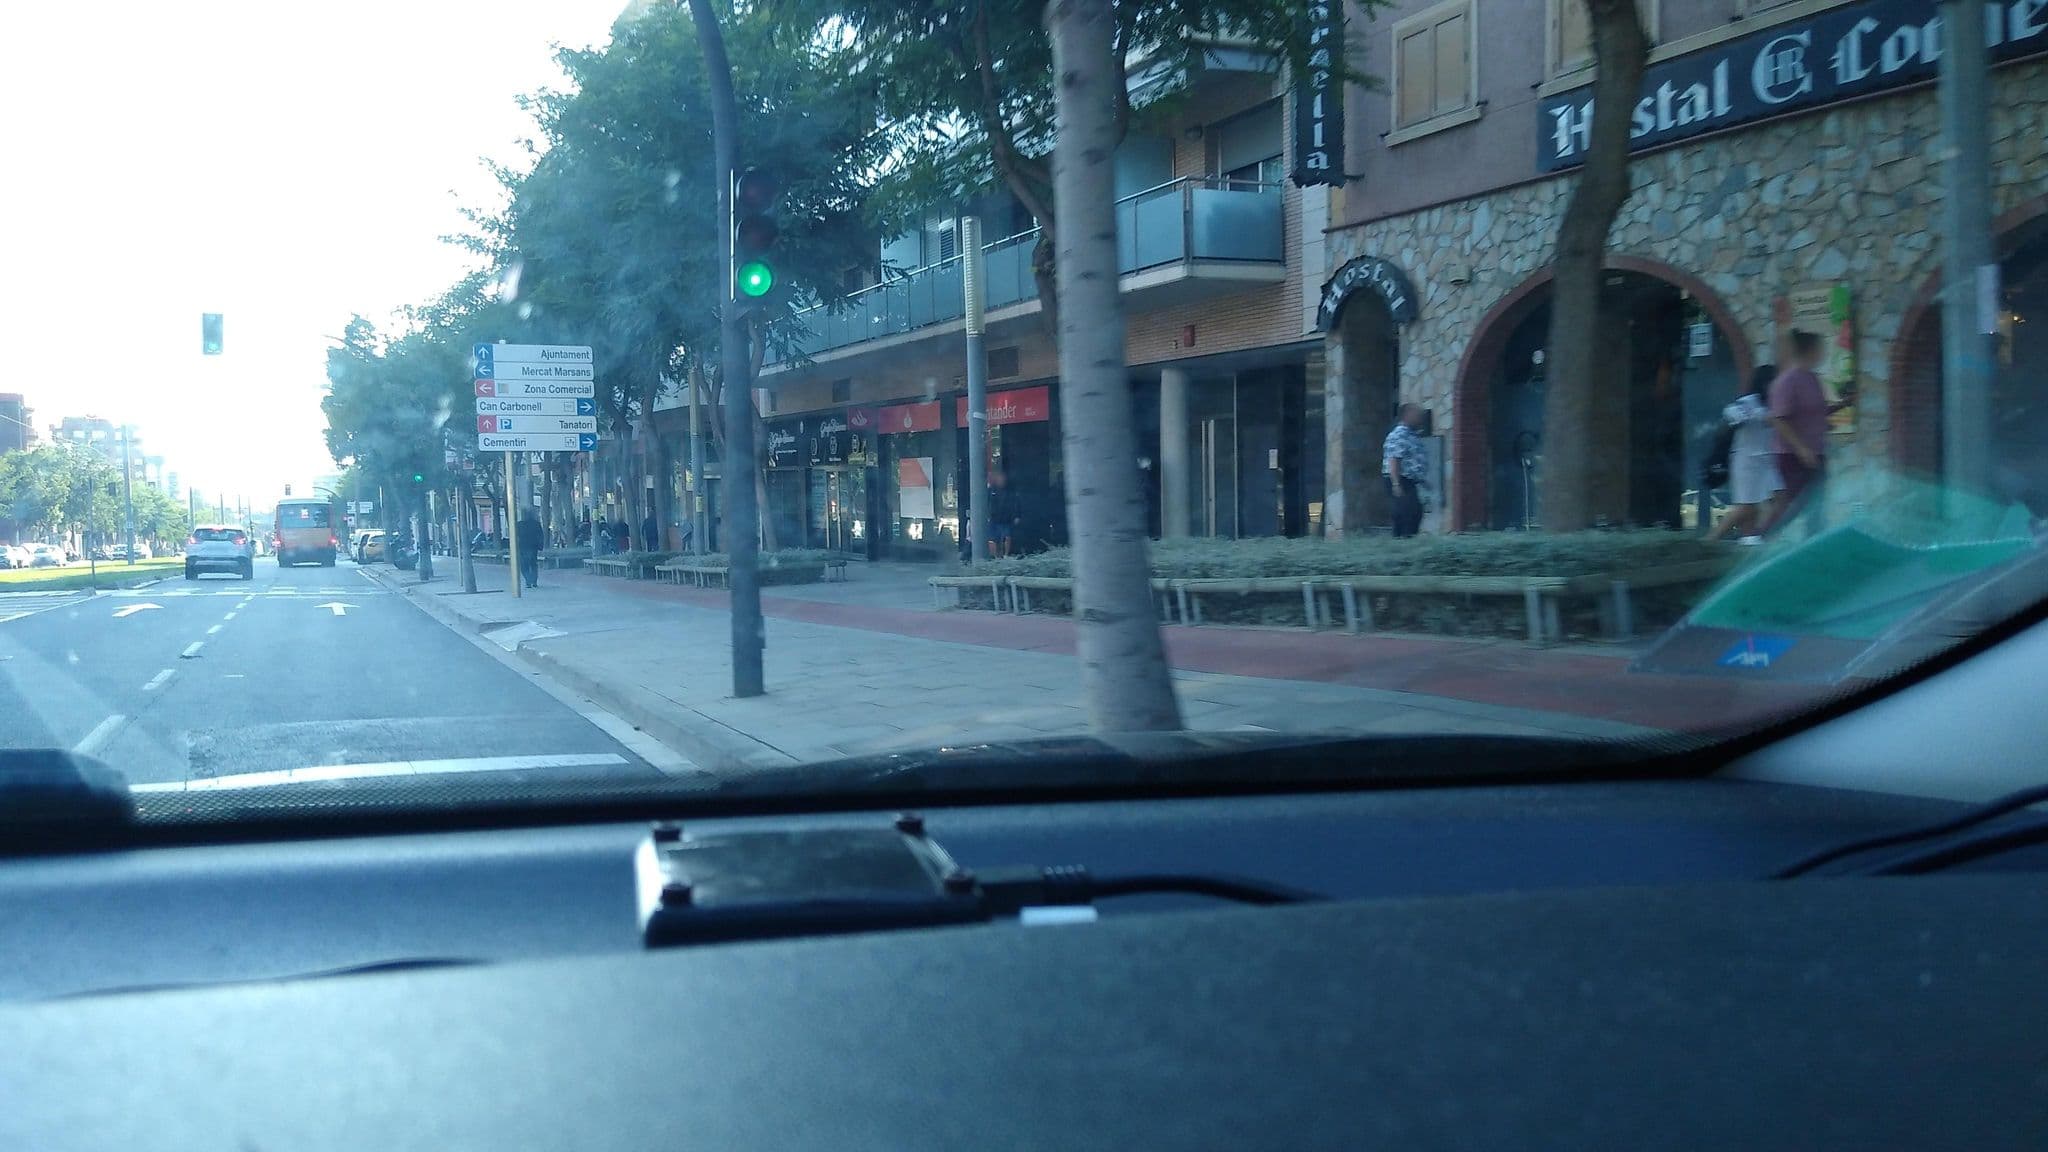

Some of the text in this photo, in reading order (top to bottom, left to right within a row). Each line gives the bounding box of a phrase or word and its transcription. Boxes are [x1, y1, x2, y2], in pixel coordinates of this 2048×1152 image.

[1549, 58, 1733, 159] Hstal
[1322, 263, 1407, 314] Hostal
[541, 349, 590, 361] Ajuntament
[521, 366, 591, 377] Mercat Marsans
[524, 384, 592, 394] Zona Comercial
[479, 401, 542, 411] Can Carbonell
[559, 419, 593, 429] Tanatori
[483, 437, 527, 447] Cementiri
